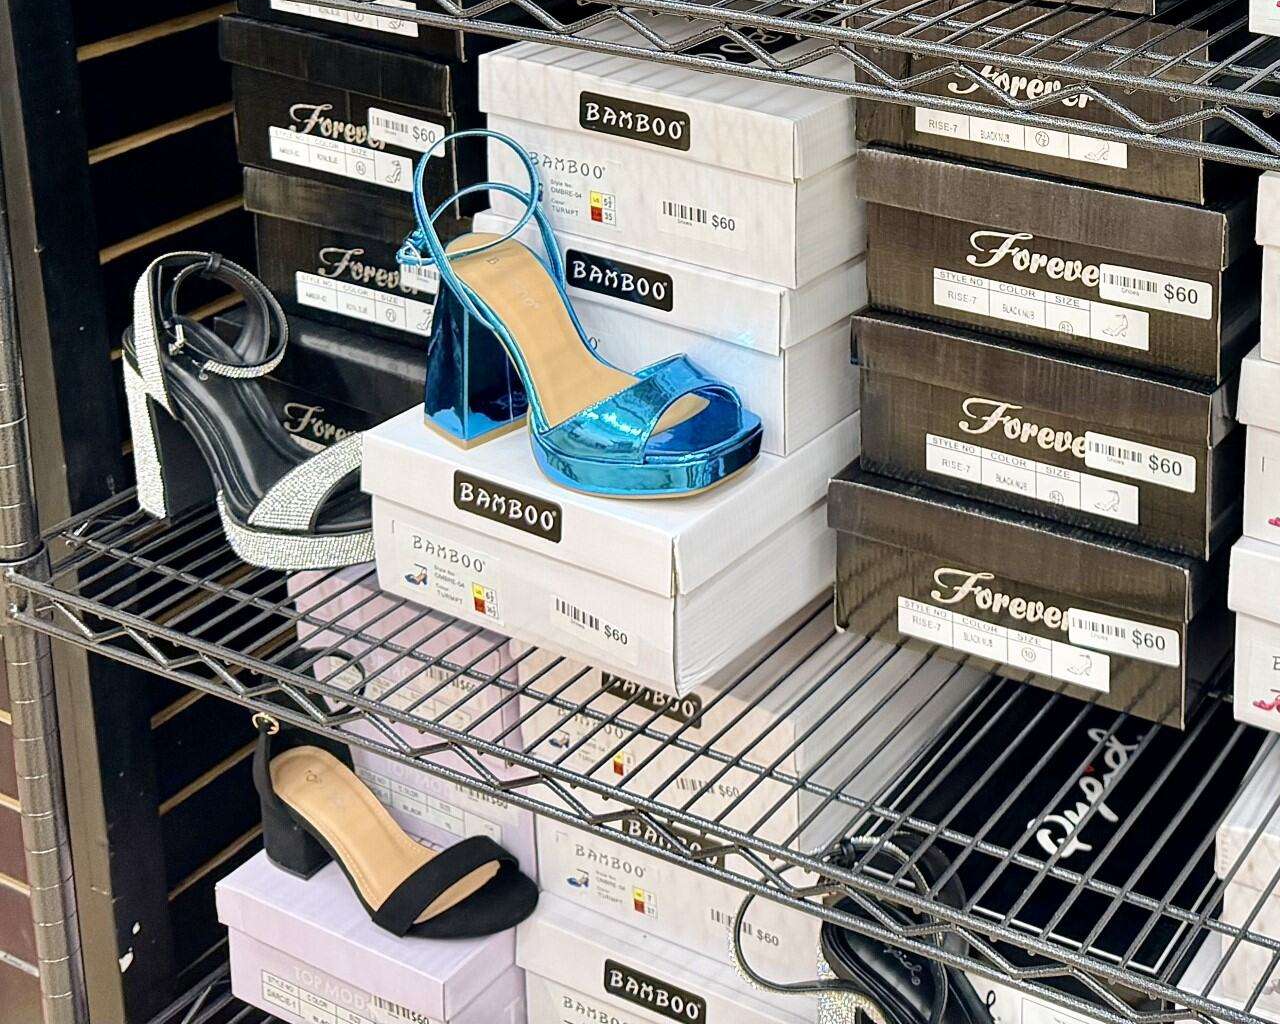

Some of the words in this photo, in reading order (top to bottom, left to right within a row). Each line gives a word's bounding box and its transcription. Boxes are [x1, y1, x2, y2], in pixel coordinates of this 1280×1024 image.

[412, 126, 435, 143] $60
[929, 120, 958, 133] RISE-7
[712, 214, 735, 231] $60
[966, 231, 1100, 287] Foreve
[948, 289, 977, 304] RISE-7
[999, 283, 1036, 298] COLOR
[1164, 286, 1198, 304] $60
[1055, 296, 1080, 307] SIZE
[959, 397, 1086, 458] Foreve
[991, 452, 1027, 468] COLOR
[1149, 454, 1182, 476] $60
[1046, 467, 1071, 478] SIZE
[604, 624, 628, 645] $60
[1132, 629, 1165, 650] $60
[757, 934, 779, 947] $60
